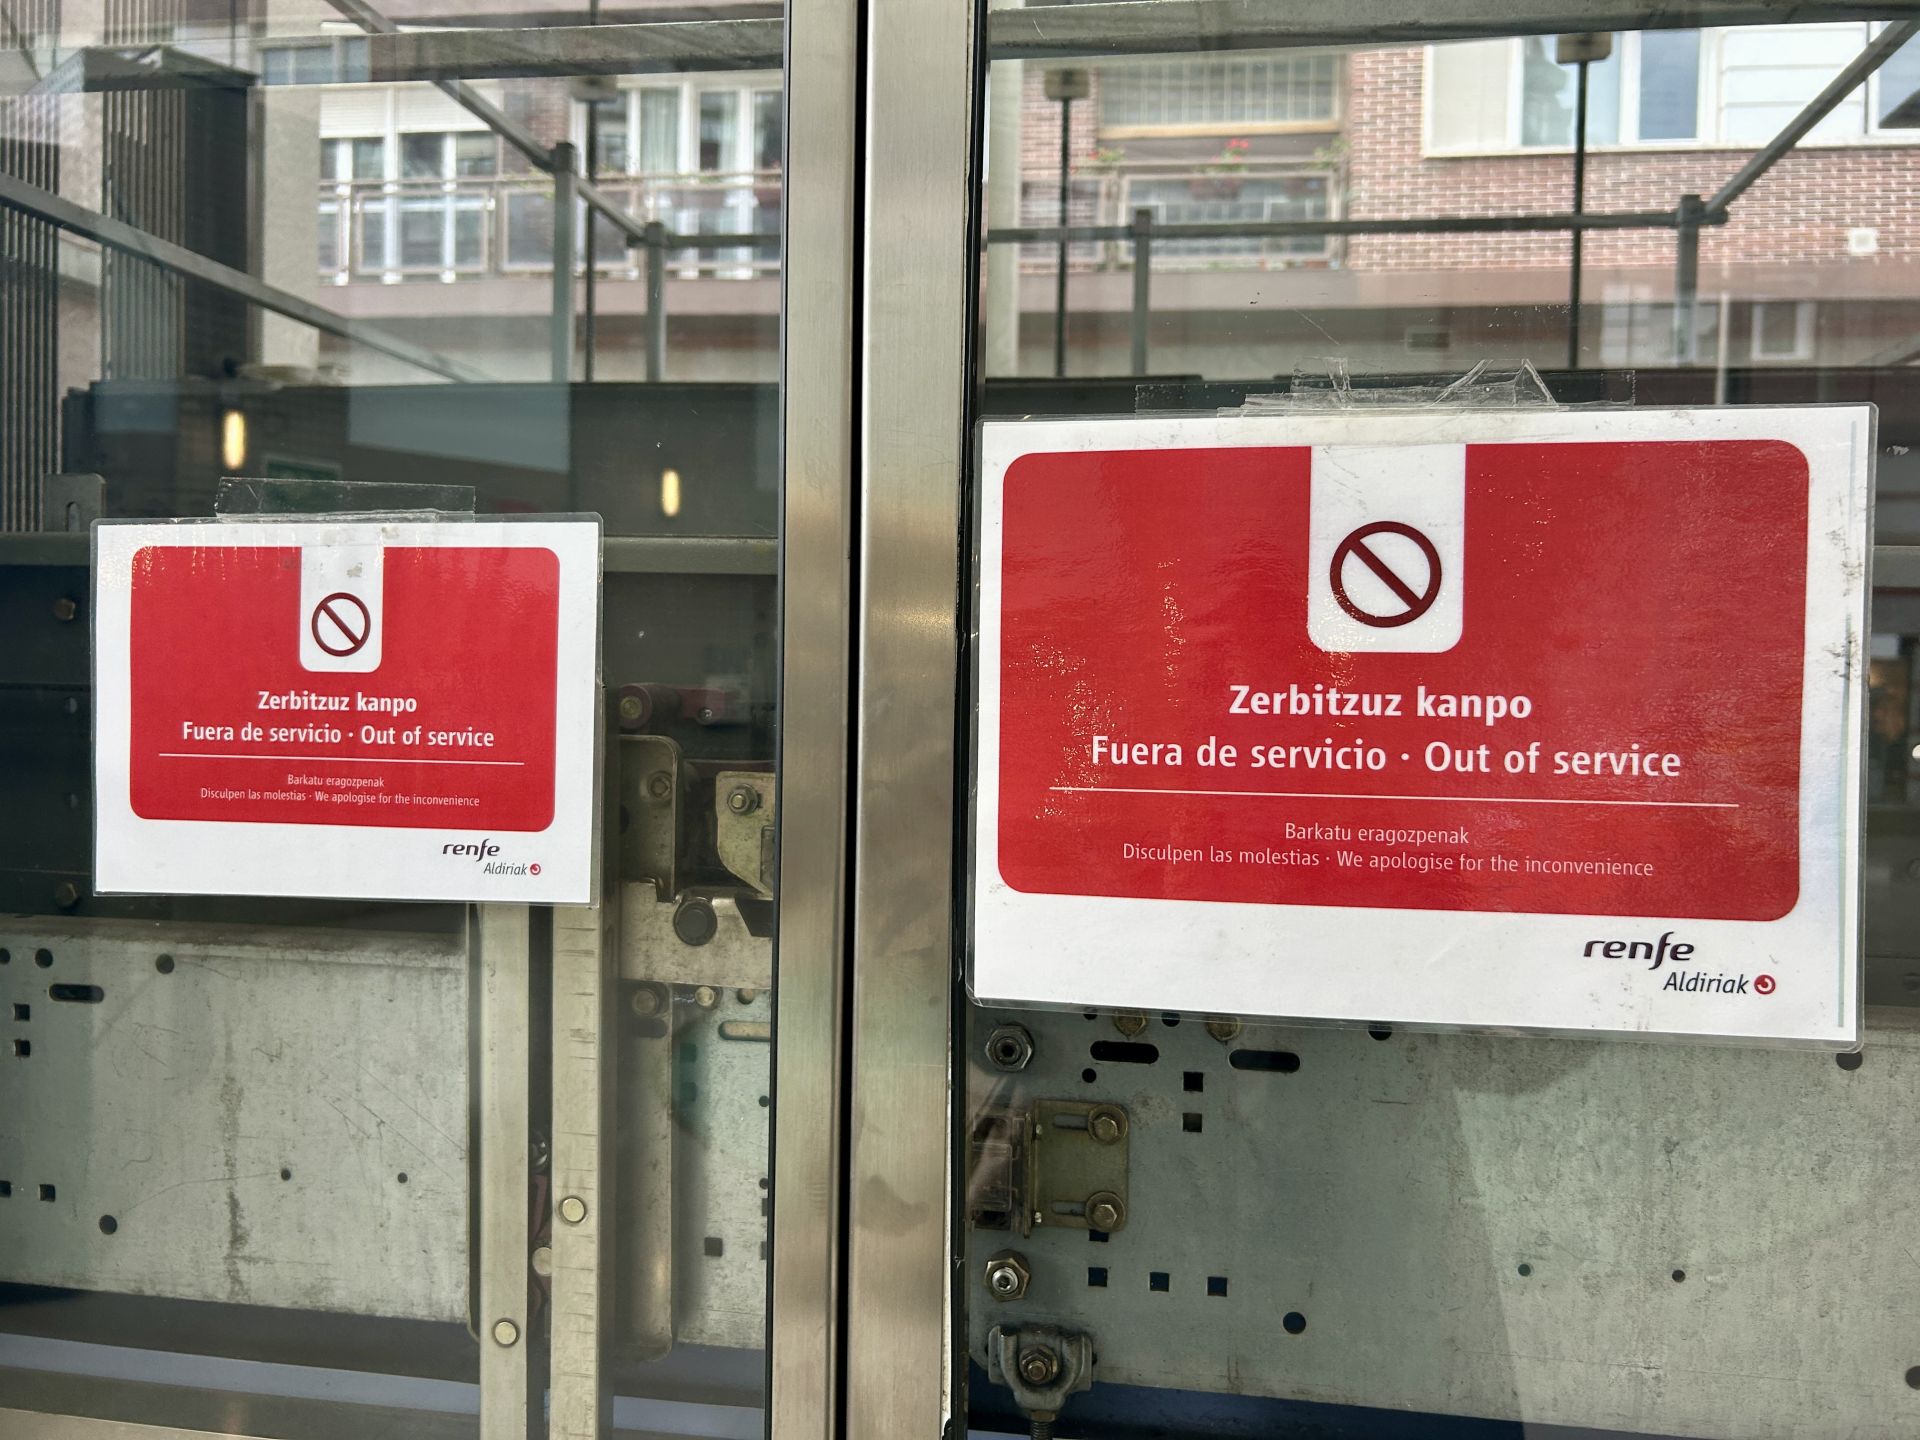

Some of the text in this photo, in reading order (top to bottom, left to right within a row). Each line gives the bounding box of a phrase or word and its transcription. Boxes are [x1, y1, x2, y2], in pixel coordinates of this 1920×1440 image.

[258, 691, 417, 716] Zerbitzuz kanpo
[1229, 684, 1531, 726] Zerbitzuz kanpo
[184, 722, 233, 740] Fuera
[241, 722, 263, 741] de
[270, 723, 341, 743] servicio
[361, 726, 395, 744] Out
[403, 726, 421, 744] of
[428, 727, 494, 746] service
[1091, 734, 1181, 766] Fuera
[1197, 736, 1237, 767] de
[1251, 738, 1386, 770] servicio
[1425, 742, 1490, 772] Out
[1504, 742, 1540, 773] of
[1554, 744, 1680, 776] service
[288, 774, 384, 789] Barkatu eragozpenak
[201, 788, 245, 800] Disculpen
[249, 789, 260, 799] las
[264, 790, 306, 800] molestias
[315, 791, 329, 801] We
[332, 792, 376, 805] apologise
[379, 793, 392, 803] for
[395, 793, 410, 804] the
[413, 794, 479, 806] inconvenience
[1286, 823, 1469, 846] Barkatu eragozpenak
[443, 839, 501, 862] renfe
[1124, 844, 1202, 864] Disculpen
[1211, 846, 1232, 862] las
[1240, 848, 1319, 865] molestias
[1337, 851, 1362, 867] We
[1370, 852, 1453, 873] apologise
[1460, 854, 1483, 870] for
[1491, 855, 1518, 871] the
[1525, 856, 1653, 875] inconvenience
[484, 862, 527, 875] Aldiriak
[1584, 932, 1694, 970] renfe
[1663, 971, 1749, 994] Aldiriak
